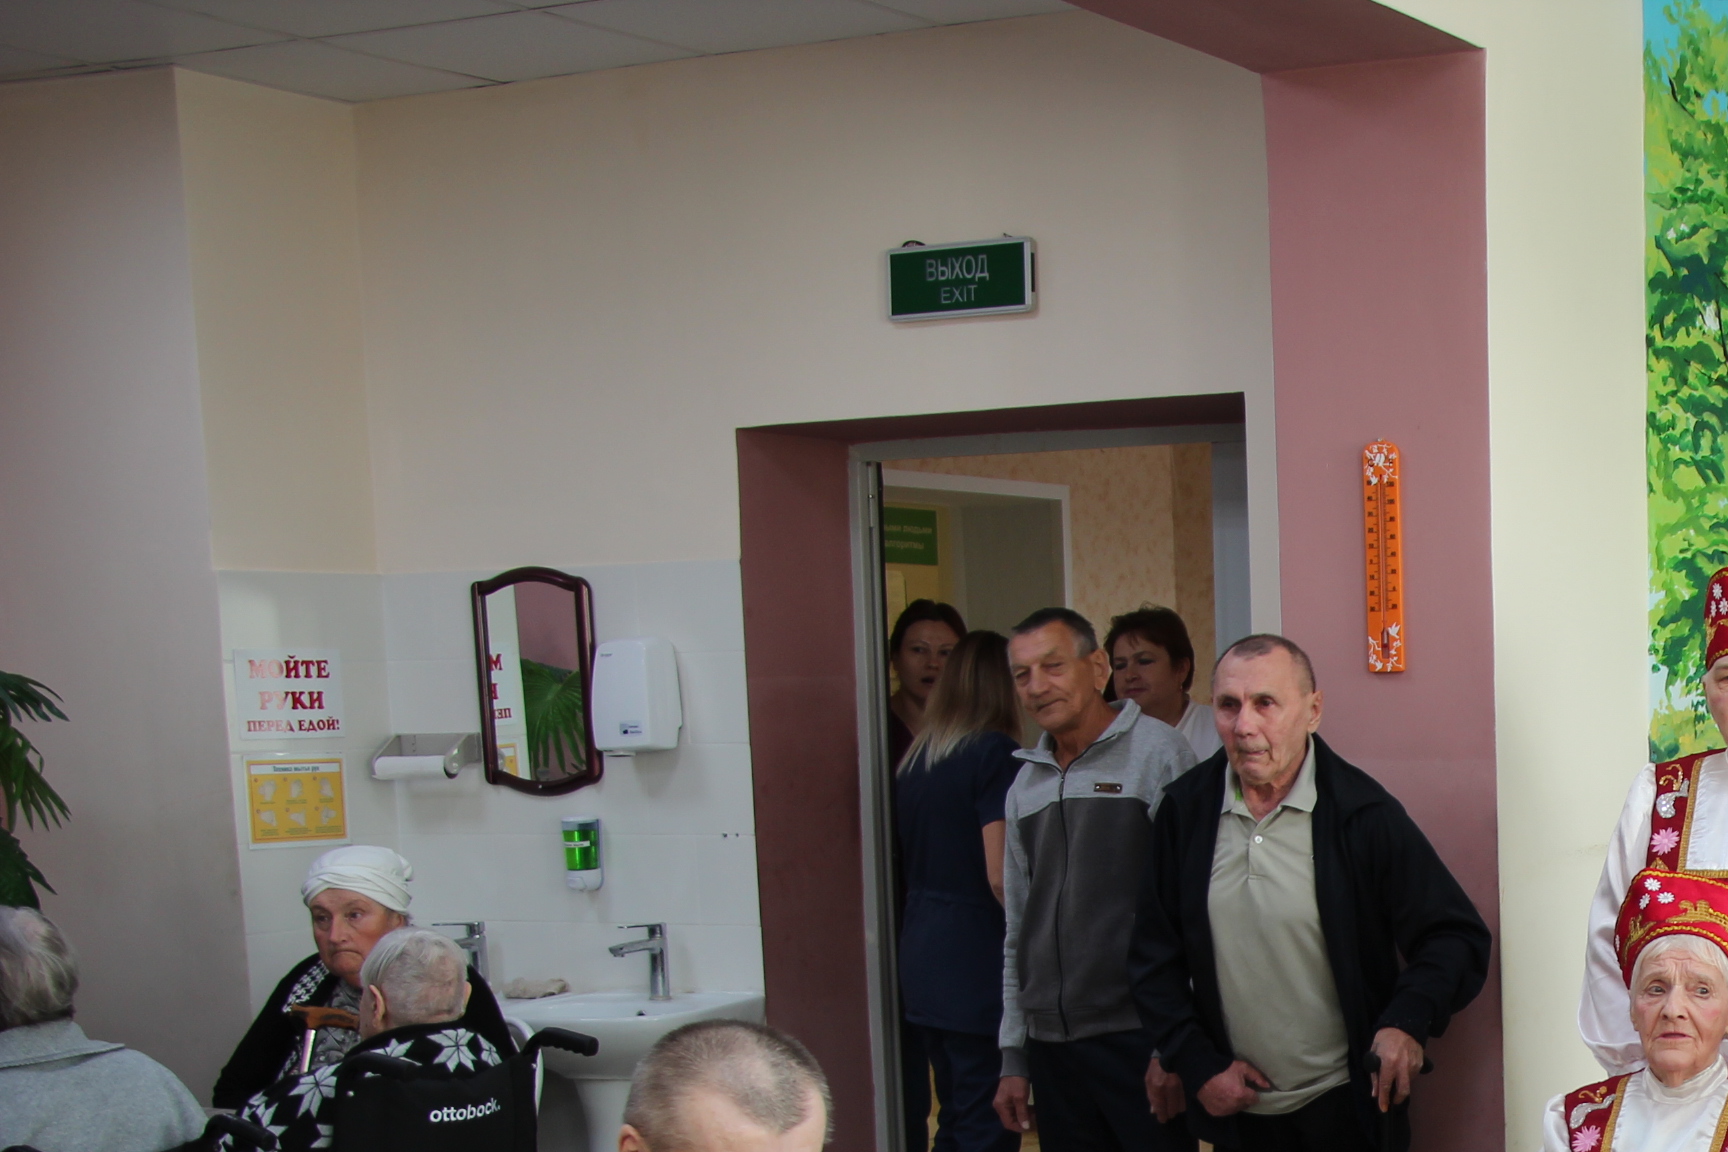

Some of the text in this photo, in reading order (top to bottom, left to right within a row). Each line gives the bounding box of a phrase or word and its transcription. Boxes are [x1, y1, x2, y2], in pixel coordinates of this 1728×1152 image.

[925, 254, 990, 282] ВЫХОД
[940, 284, 978, 304] EXIT
[247, 655, 331, 679] МОЙТЕ
[258, 690, 325, 710] РУКИ
[247, 716, 340, 733] ПЕРЕД ЕДОЙ!
